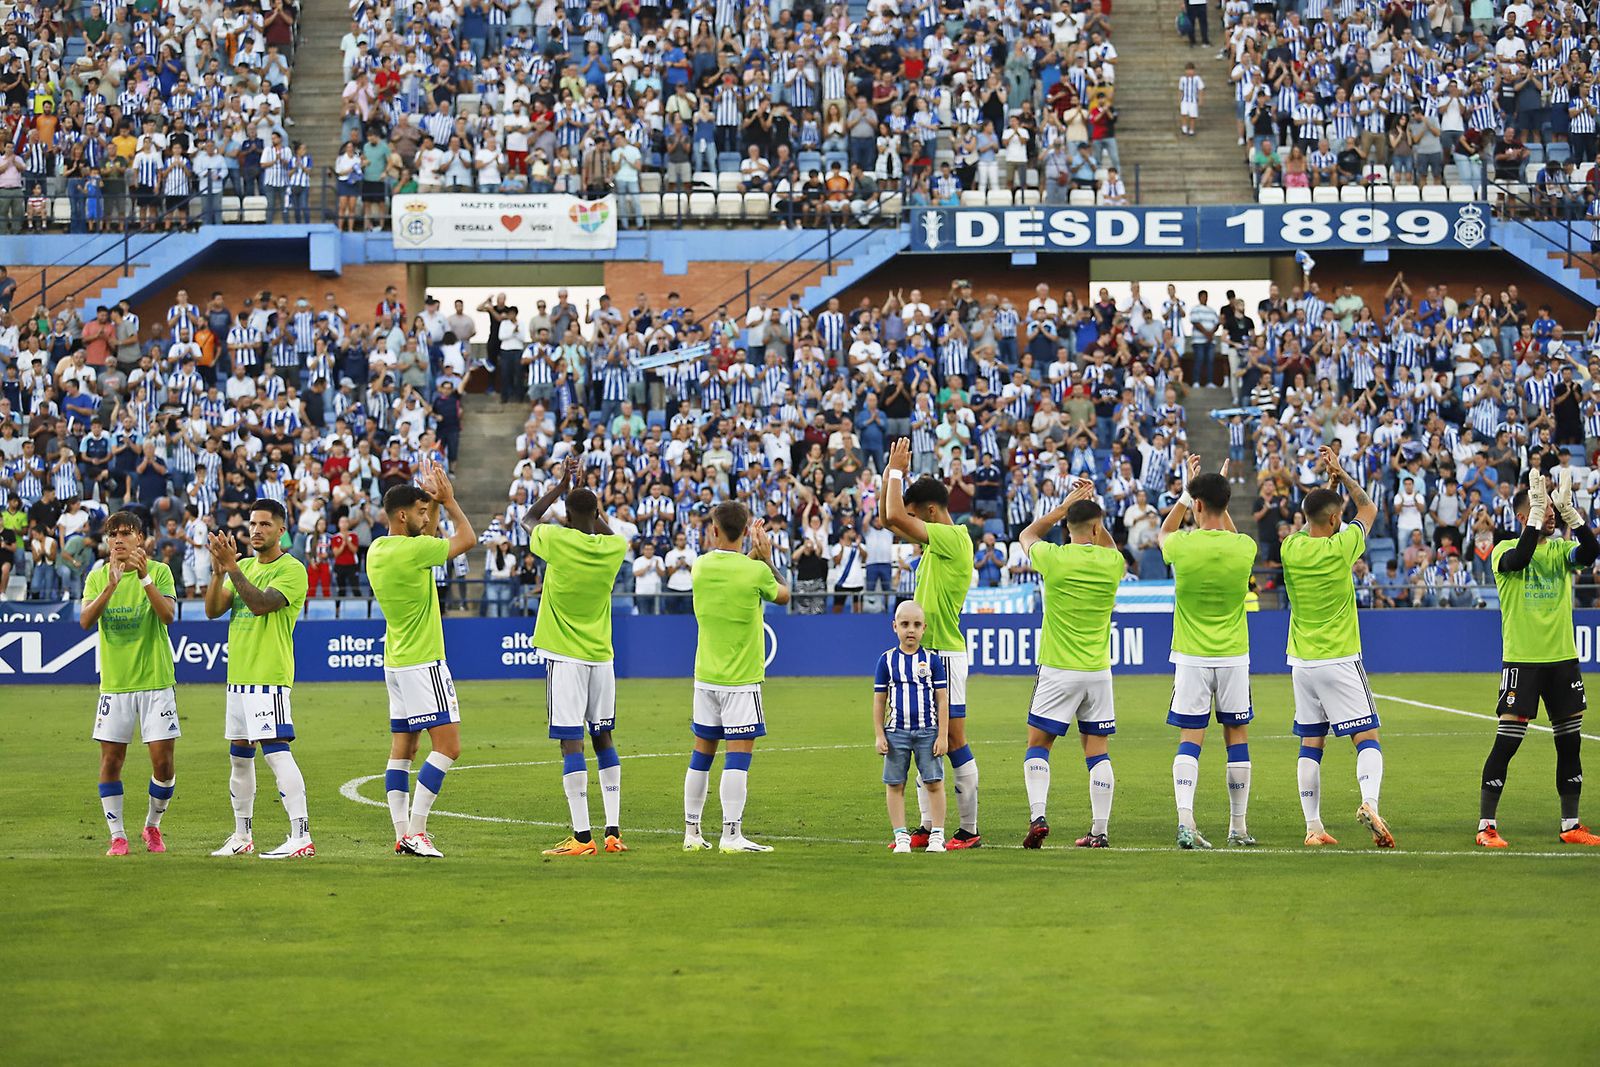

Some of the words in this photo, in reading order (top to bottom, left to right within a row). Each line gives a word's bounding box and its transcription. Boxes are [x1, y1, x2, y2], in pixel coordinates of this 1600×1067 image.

[955, 210, 1184, 247] DESDE
[1225, 208, 1449, 245] 1889
[327, 634, 375, 652] alter
[1337, 717, 1373, 731] ROMERO
